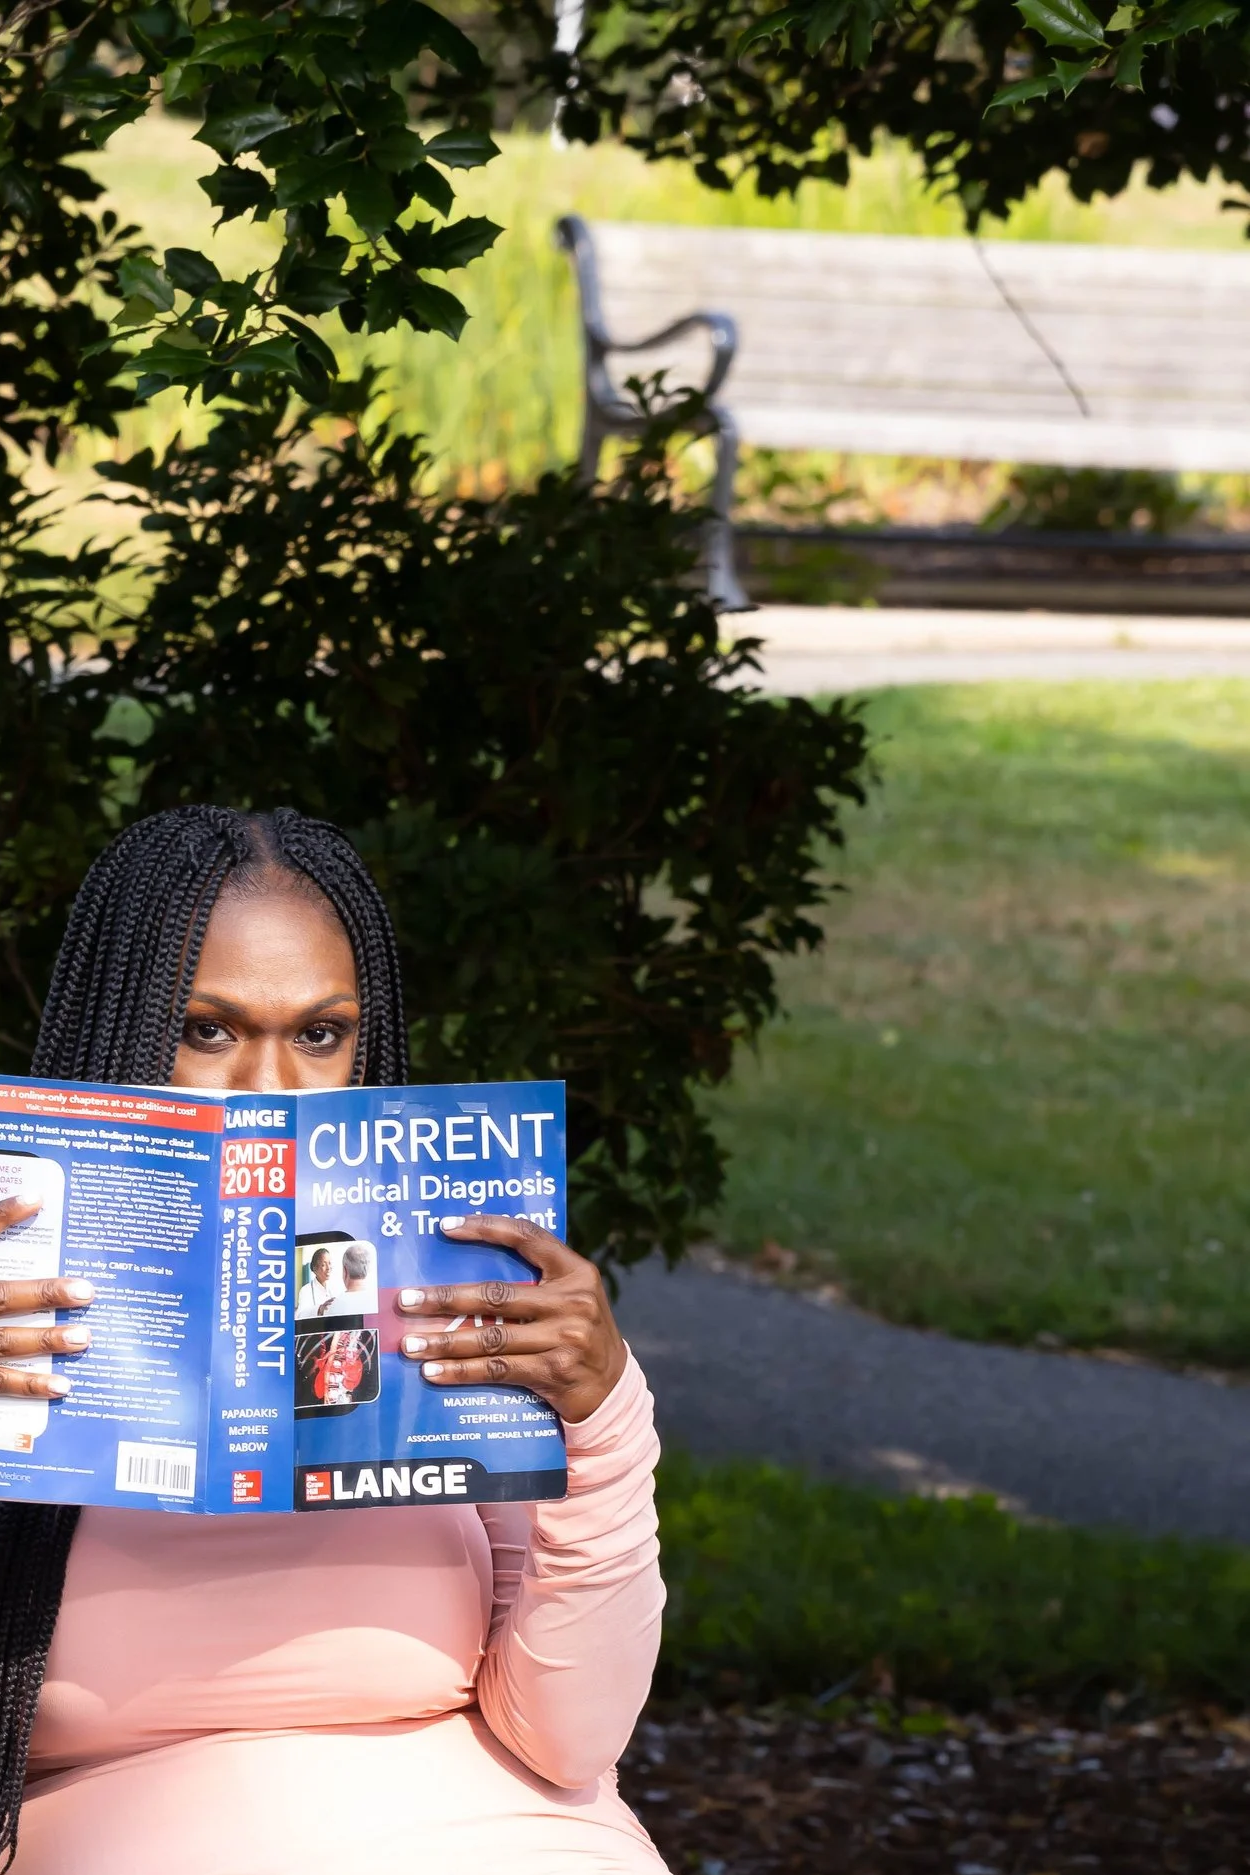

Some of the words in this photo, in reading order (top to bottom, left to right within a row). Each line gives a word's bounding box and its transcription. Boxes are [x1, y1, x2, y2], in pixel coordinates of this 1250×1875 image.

[10, 1089, 17, 1098] 6
[18, 1090, 68, 1104] online-only
[69, 1093, 109, 1107] chapters
[110, 1098, 121, 1108] at
[122, 1100, 134, 1109] no
[135, 1102, 175, 1115] additional
[176, 1106, 197, 1117] cost!
[225, 1109, 287, 1129] LANGE
[8, 1132, 22, 1143] the
[35, 1136, 71, 1149] annually
[71, 1139, 109, 1151] updated
[109, 1142, 134, 1153] guide
[135, 1144, 144, 1154] to
[145, 1145, 174, 1158] internal
[174, 1150, 210, 1162] medicine
[20, 1122, 34, 1133] the
[35, 1123, 60, 1135] latest
[61, 1127, 97, 1138] research
[99, 1128, 132, 1143] findings
[133, 1131, 150, 1144] into
[150, 1136, 168, 1146] your
[169, 1137, 194, 1149] clinical
[308, 1112, 555, 1170] CURRENT
[225, 1143, 289, 1167] CMDT
[11, 1166, 22, 1174] OF
[225, 1166, 286, 1195] 2018
[312, 1174, 409, 1208] Medical
[419, 1170, 556, 1206] Diagnosis
[222, 1207, 236, 1224] &
[380, 1210, 404, 1238] &
[236, 1206, 253, 1285] Medical
[219, 1228, 236, 1332] Treatment
[257, 1206, 287, 1376] CURRENT
[232, 1291, 252, 1388] Diagnosis
[221, 1408, 278, 1420] PAPADAKIS
[443, 1396, 487, 1408] MAXINE
[489, 1396, 500, 1406] A.
[228, 1425, 269, 1437] McPHEE
[459, 1413, 508, 1425] STEPHEN
[229, 1442, 268, 1453] RABOW
[406, 1433, 450, 1443] ASSOCIATE
[451, 1432, 482, 1442] EDITOR
[486, 1430, 522, 1440] MICHAEL
[534, 1428, 558, 1438] RABOW
[233, 1473, 246, 1481] Mc
[233, 1480, 254, 1490] Graw
[333, 1463, 469, 1501] LANGE
